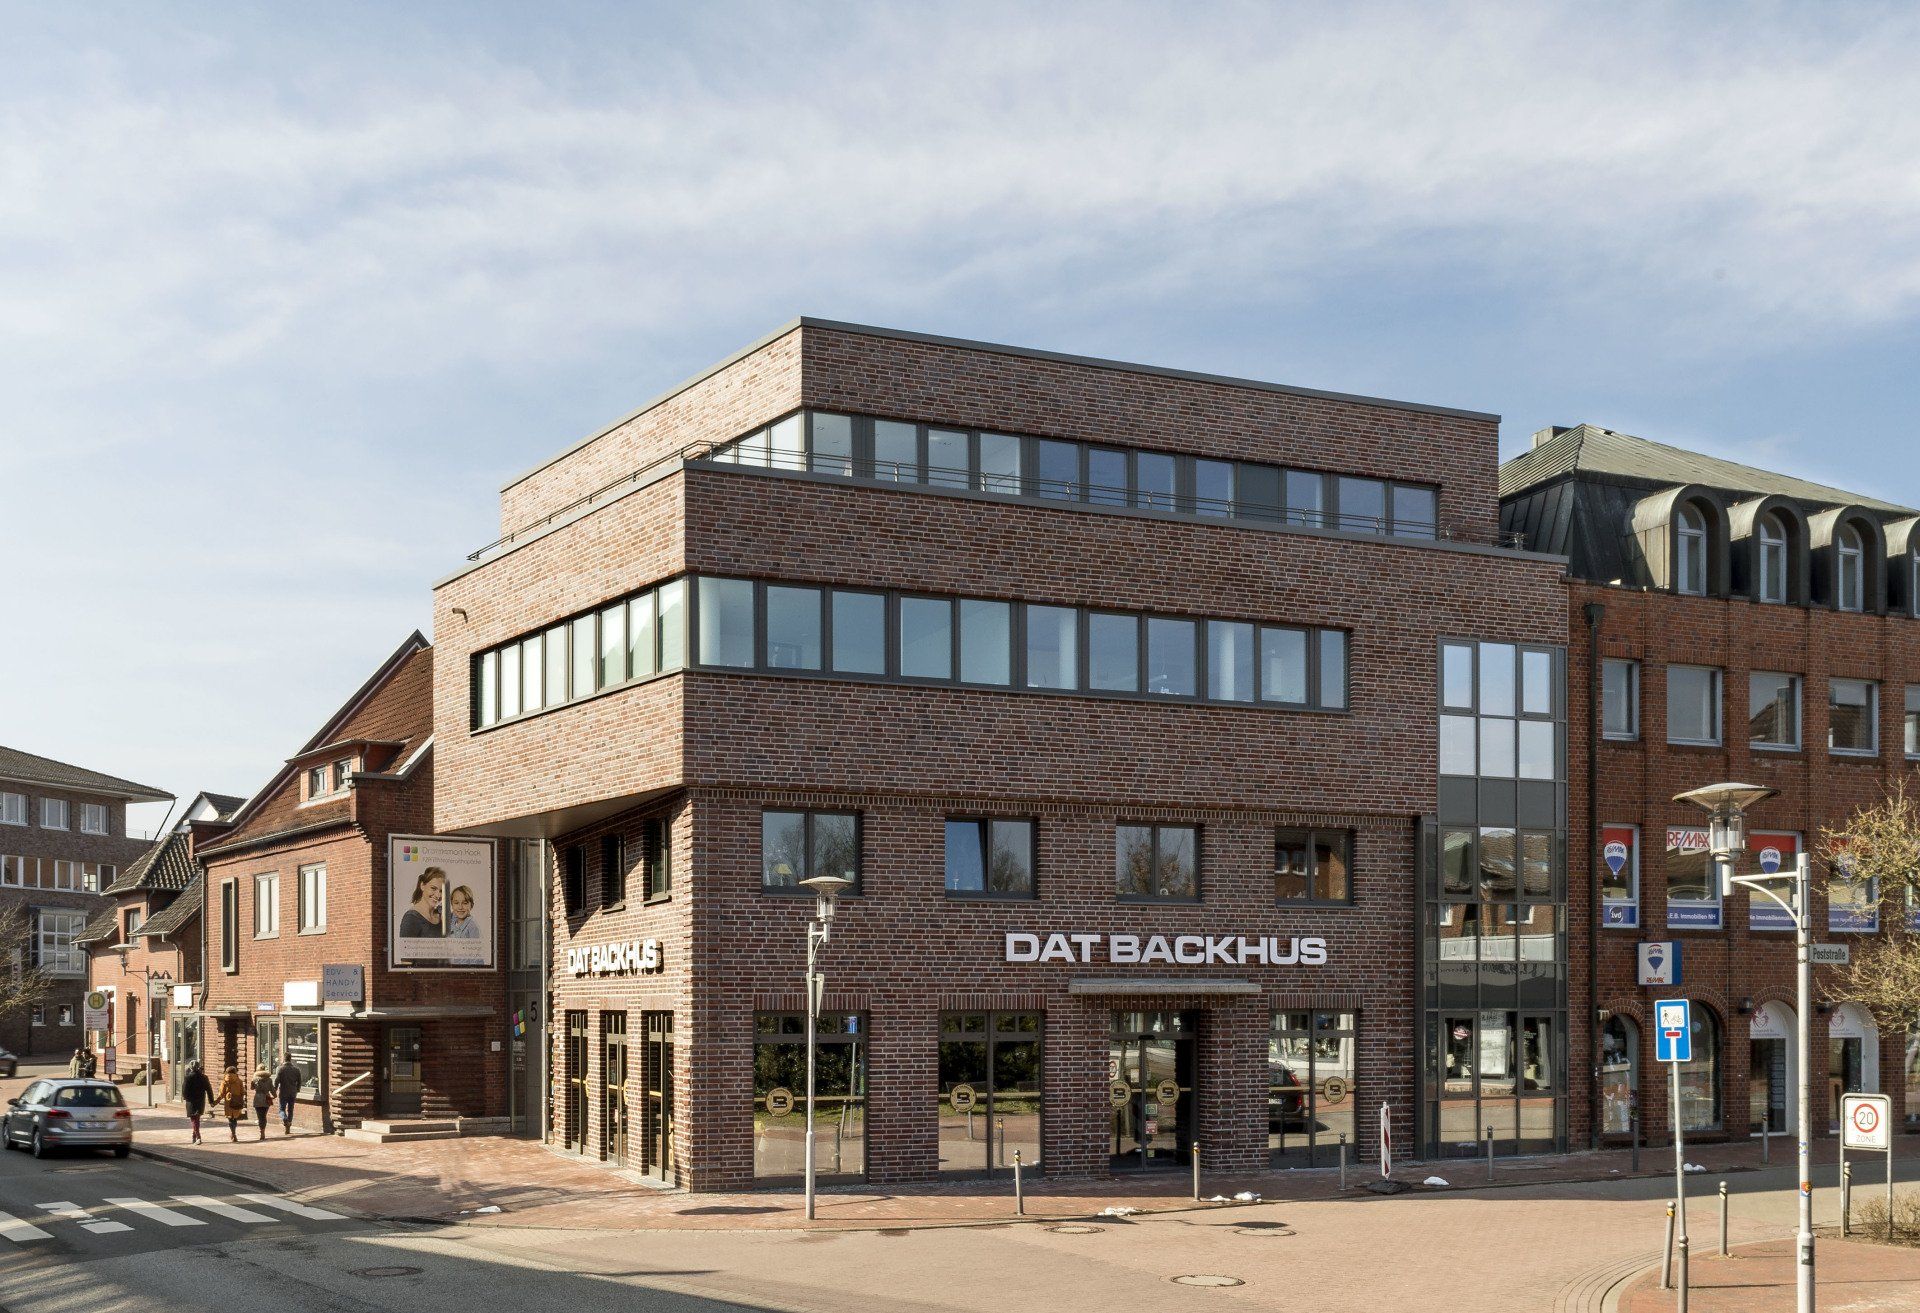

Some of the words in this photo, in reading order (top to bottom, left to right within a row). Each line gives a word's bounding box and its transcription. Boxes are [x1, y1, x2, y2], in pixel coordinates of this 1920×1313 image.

[1667, 831, 1711, 848] RE/MAX
[567, 947, 590, 973] DAT
[591, 939, 657, 972] BACKHUS
[1005, 932, 1101, 963] DAT
[1109, 935, 1327, 965] BACKHUS
[1812, 947, 1846, 960] Poststraße
[530, 1001, 538, 1022] 5
[1859, 1111, 1874, 1125] 20
[1856, 1134, 1876, 1143] ZONE
